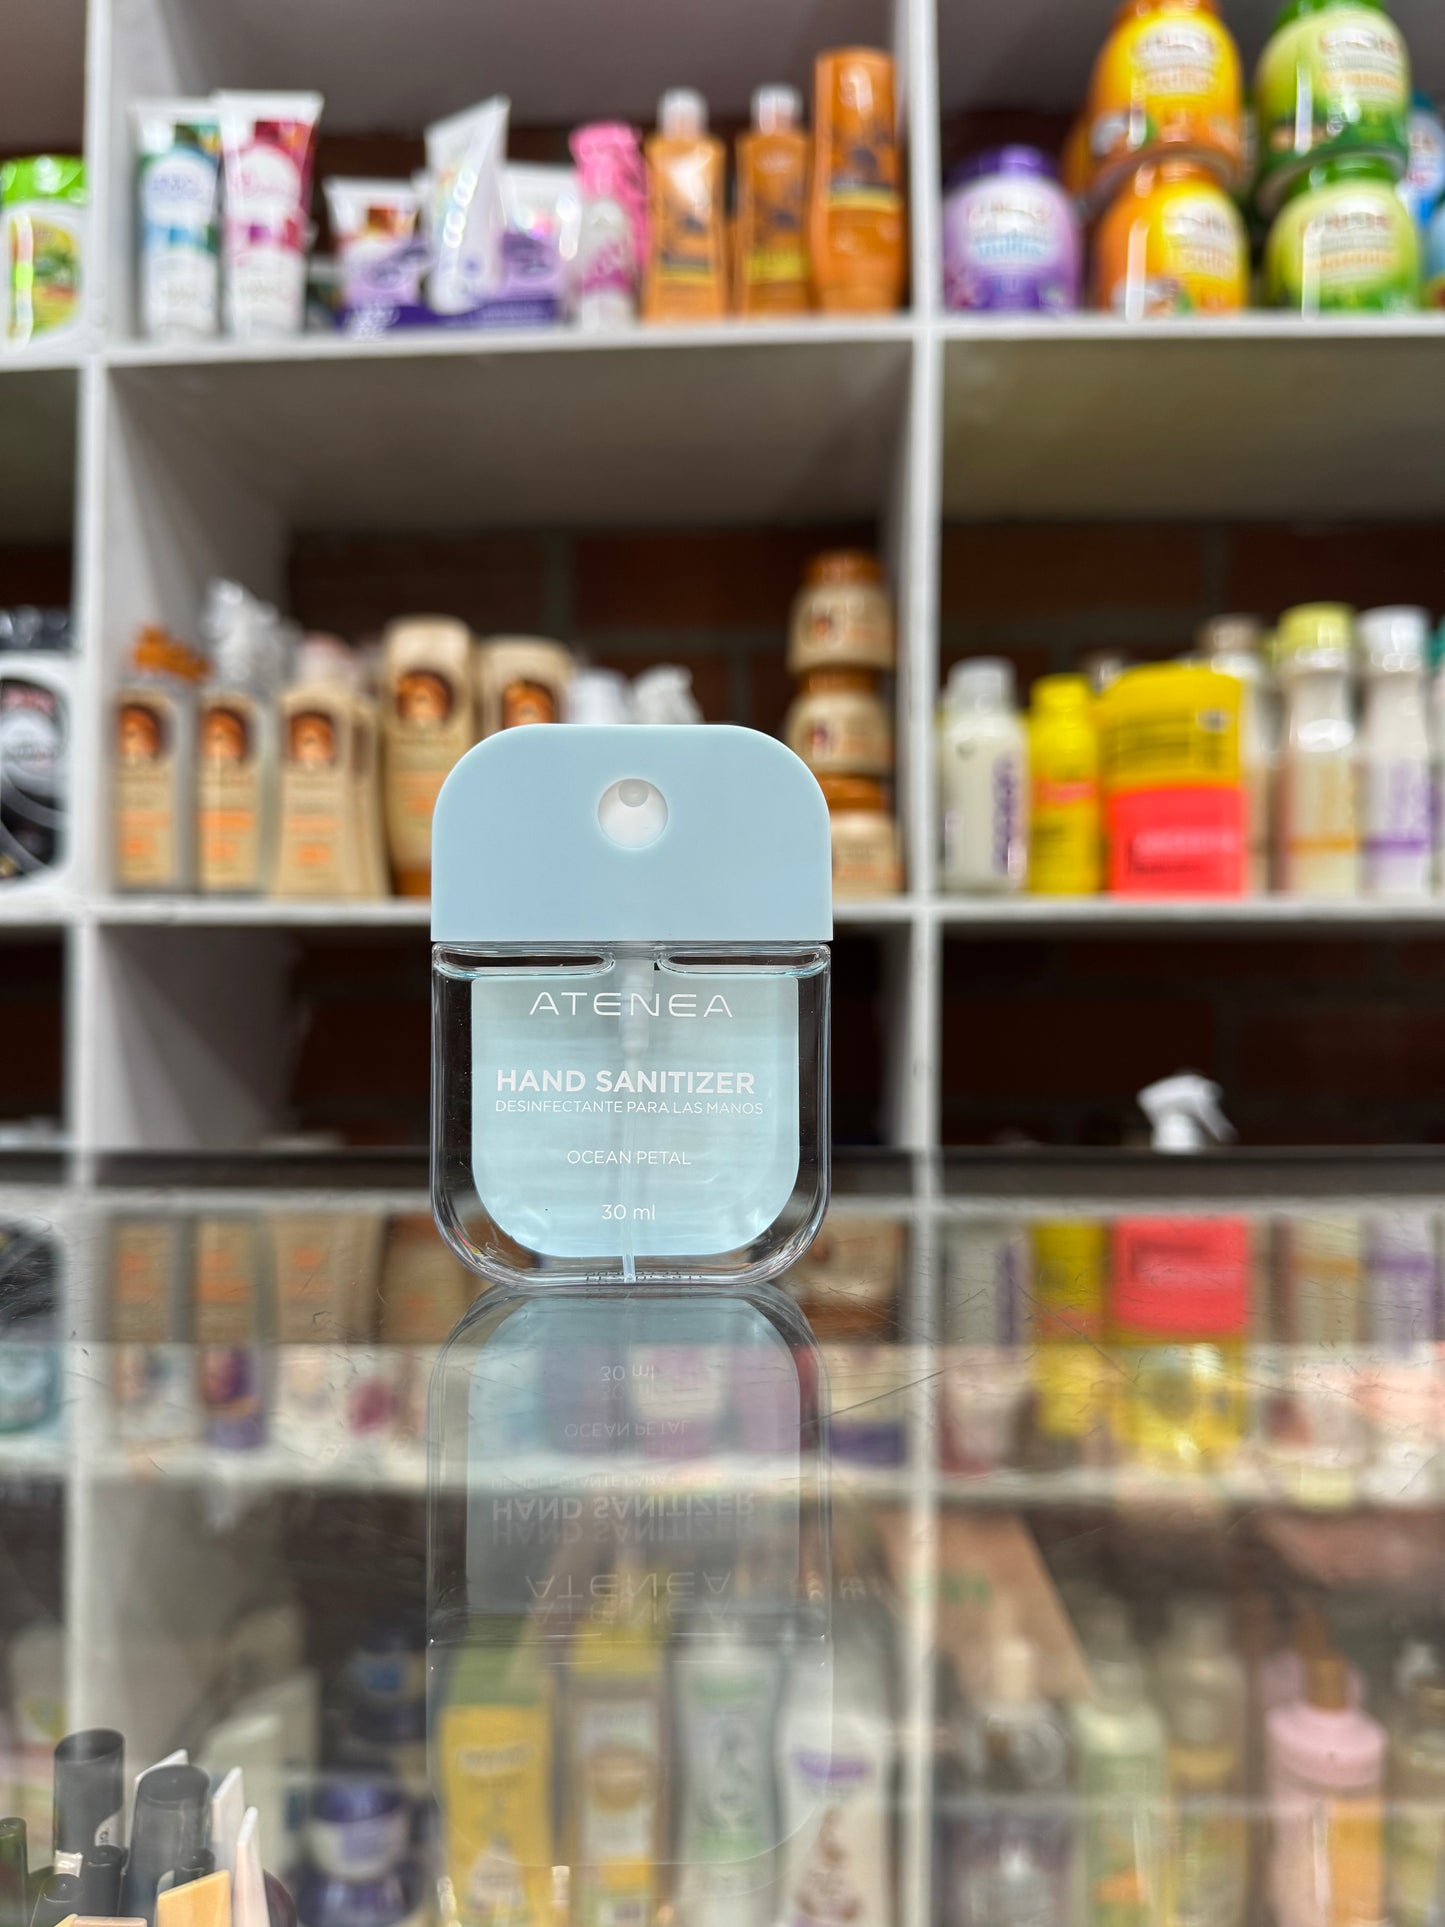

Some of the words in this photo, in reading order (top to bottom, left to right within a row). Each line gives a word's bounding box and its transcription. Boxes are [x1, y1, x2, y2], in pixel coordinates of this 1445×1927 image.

[529, 991, 733, 1018] ATENEA
[496, 1070, 586, 1093] HAND
[595, 1070, 754, 1094] SANITIZER
[495, 1099, 623, 1113] DESINFECTANTE
[626, 1100, 669, 1114] PARA
[673, 1100, 702, 1114] LAS
[706, 1101, 763, 1115] MANOS
[566, 1149, 631, 1164] OCEAN
[636, 1150, 691, 1165] PETAL
[601, 1203, 626, 1220] 30
[633, 1203, 655, 1220] ml
